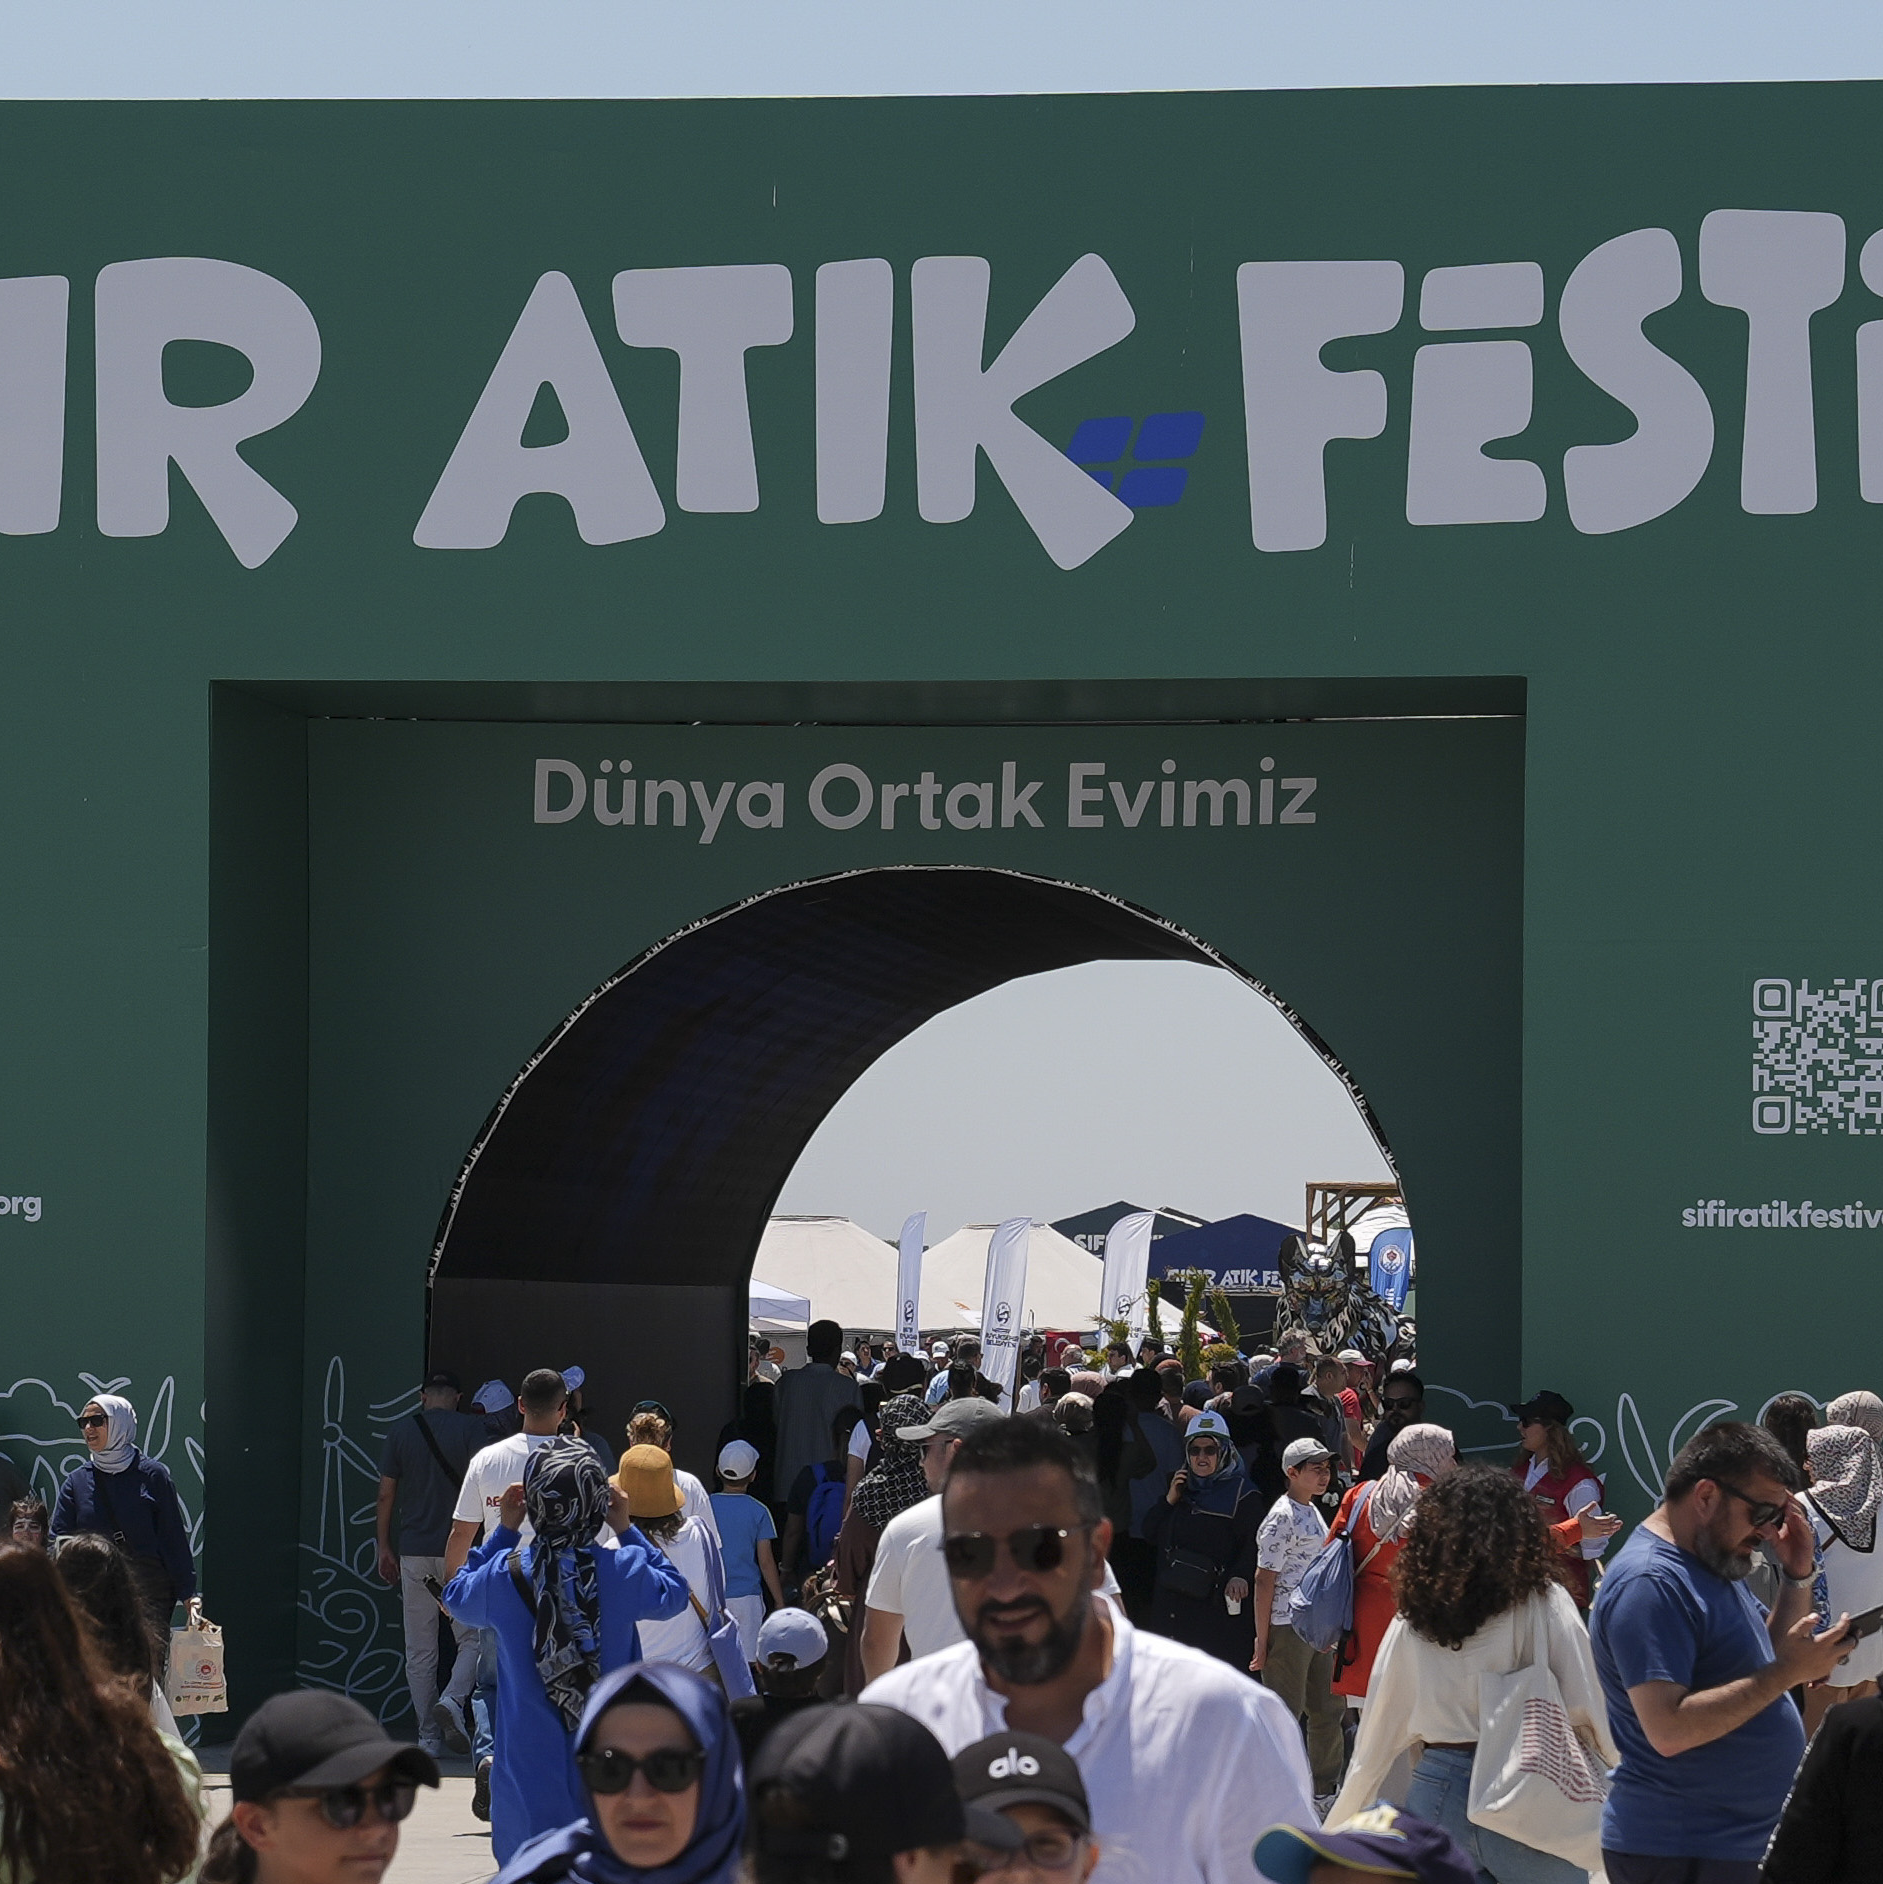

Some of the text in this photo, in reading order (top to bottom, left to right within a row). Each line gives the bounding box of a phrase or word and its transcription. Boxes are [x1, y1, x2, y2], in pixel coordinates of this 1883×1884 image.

[413, 252, 1138, 572] ATIK
[532, 756, 1318, 845] Dünya Ortak Evimiz
[1219, 1268, 1260, 1287] ATIK
[987, 1746, 1041, 1780] alo
